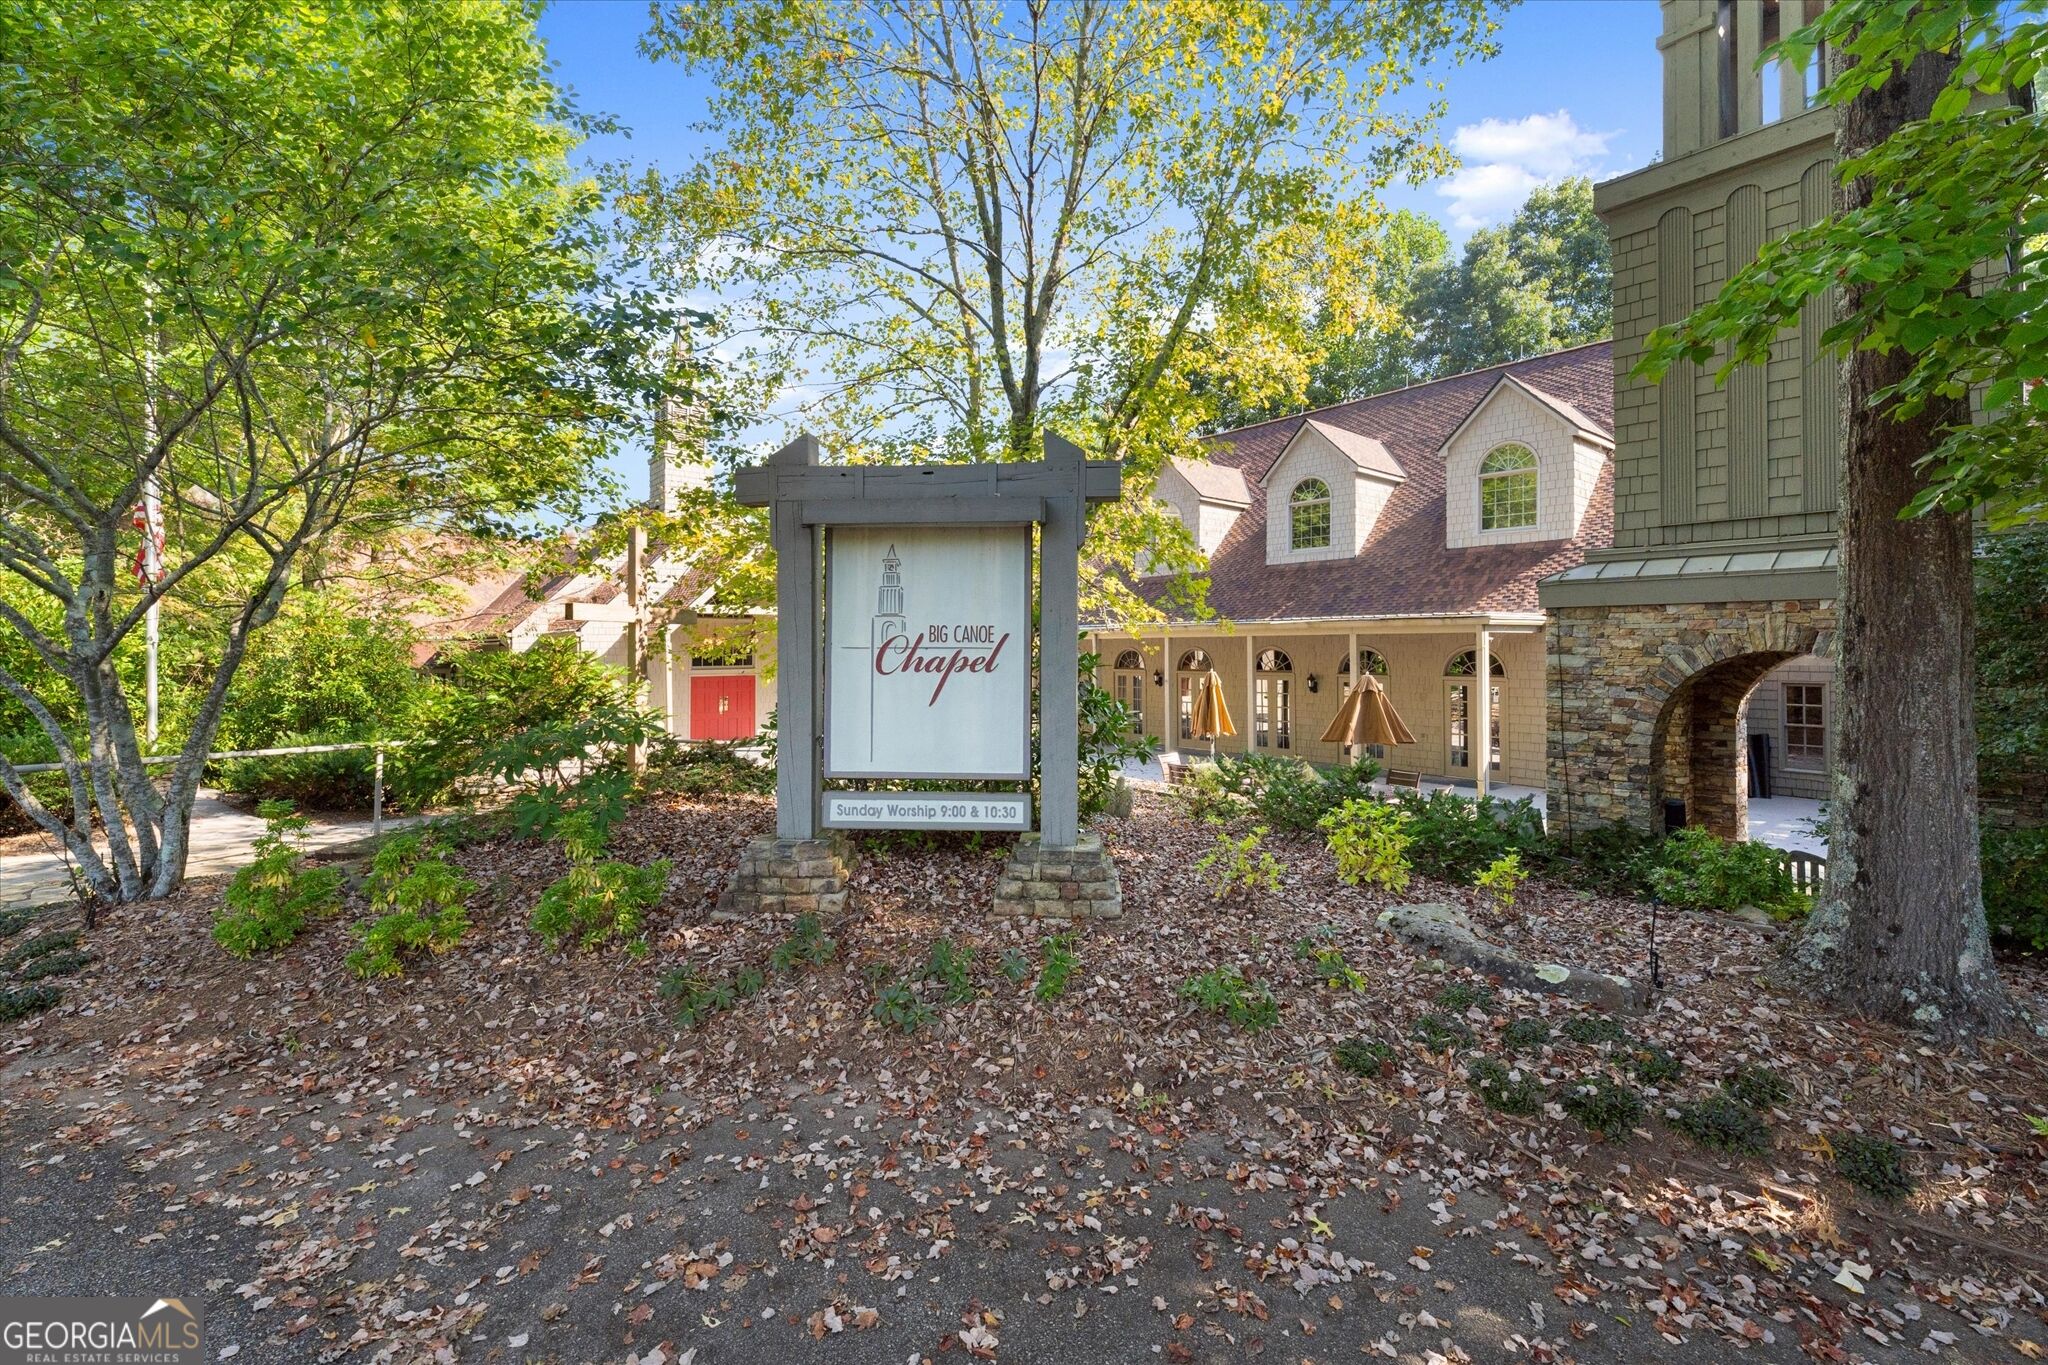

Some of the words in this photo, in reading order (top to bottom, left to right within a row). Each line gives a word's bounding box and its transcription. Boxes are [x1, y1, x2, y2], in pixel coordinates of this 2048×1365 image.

[928, 625, 948, 643] BIG
[954, 625, 994, 643] CANOE
[875, 633, 1010, 707] Chapel
[836, 803, 883, 818] Sunday
[888, 803, 936, 819] Worship
[940, 805, 966, 818] 9:00
[970, 805, 980, 818] &
[983, 806, 1016, 819] 10:30
